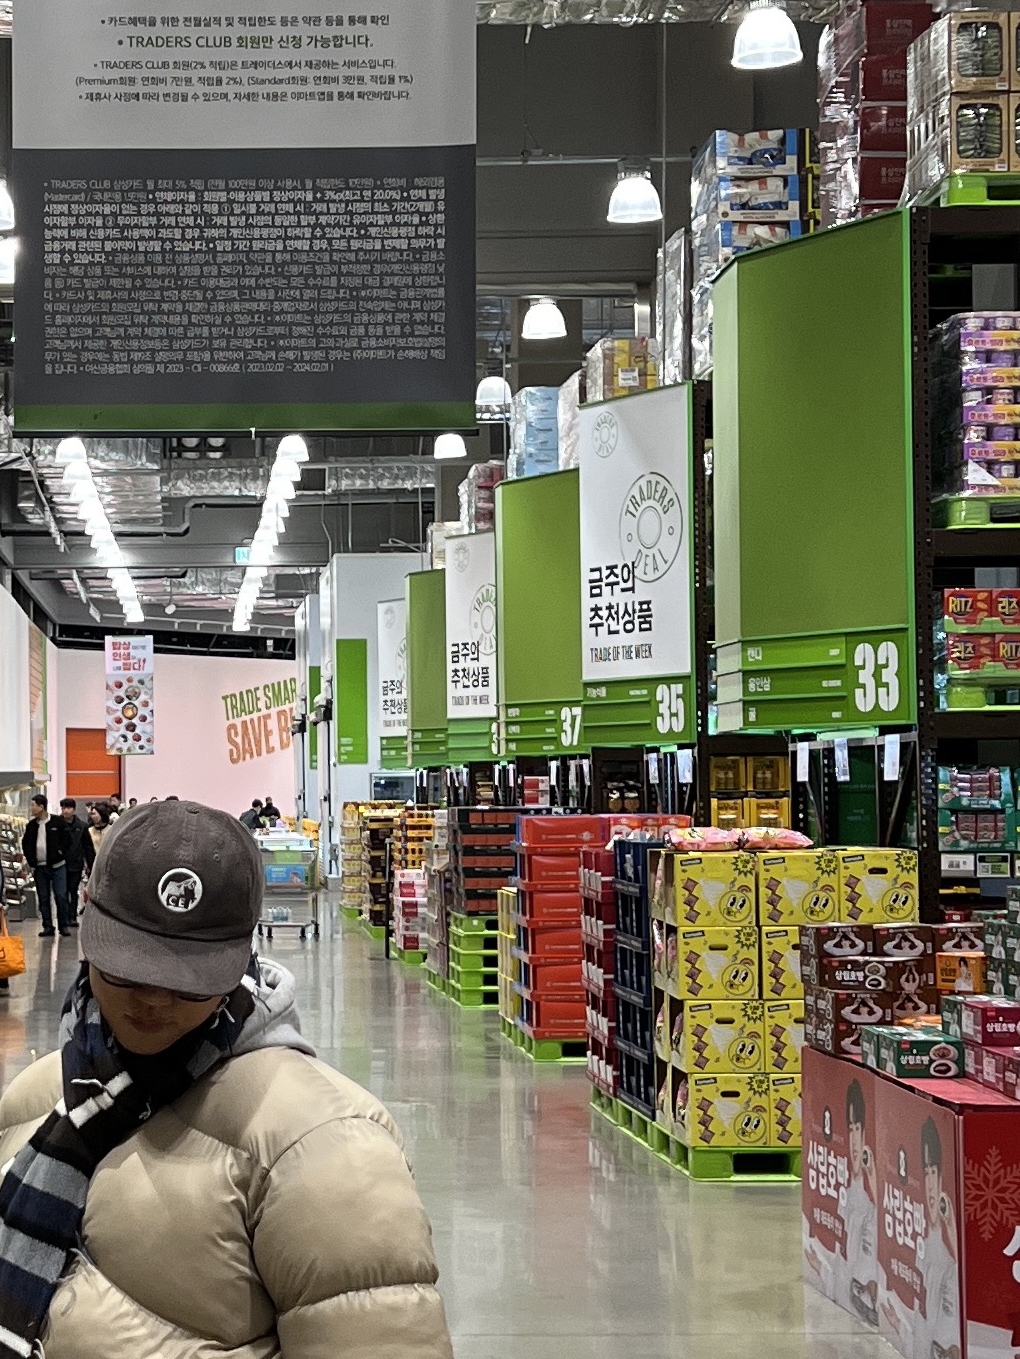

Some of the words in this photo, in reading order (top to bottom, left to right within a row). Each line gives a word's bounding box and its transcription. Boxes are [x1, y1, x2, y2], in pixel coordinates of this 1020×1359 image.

[127, 36, 191, 48] TRADERS
[196, 35, 232, 48] CLUB
[236, 35, 273, 48] 회원만
[278, 35, 302, 48] 신청
[306, 35, 373, 48] 가능합니다.
[625, 480, 675, 518] TRADERS
[588, 561, 636, 598] 금주의
[588, 600, 653, 636] 추천상품
[948, 596, 973, 613] RITZ
[451, 641, 480, 663] 금주의
[590, 646, 611, 663] TRADE
[612, 645, 620, 661] OF
[621, 644, 633, 660] THE
[382, 679, 403, 696] 금주의
[451, 667, 489, 690] 추천상품
[854, 641, 899, 713] 33
[222, 686, 261, 721] TRADE
[263, 677, 296, 710] SMAR
[655, 683, 685, 734] 35
[227, 713, 275, 765] SAVE
[560, 706, 581, 747] 37
[807, 1140, 849, 1208] 삼립호빵
[883, 1183, 926, 1260] 삼립호빵
